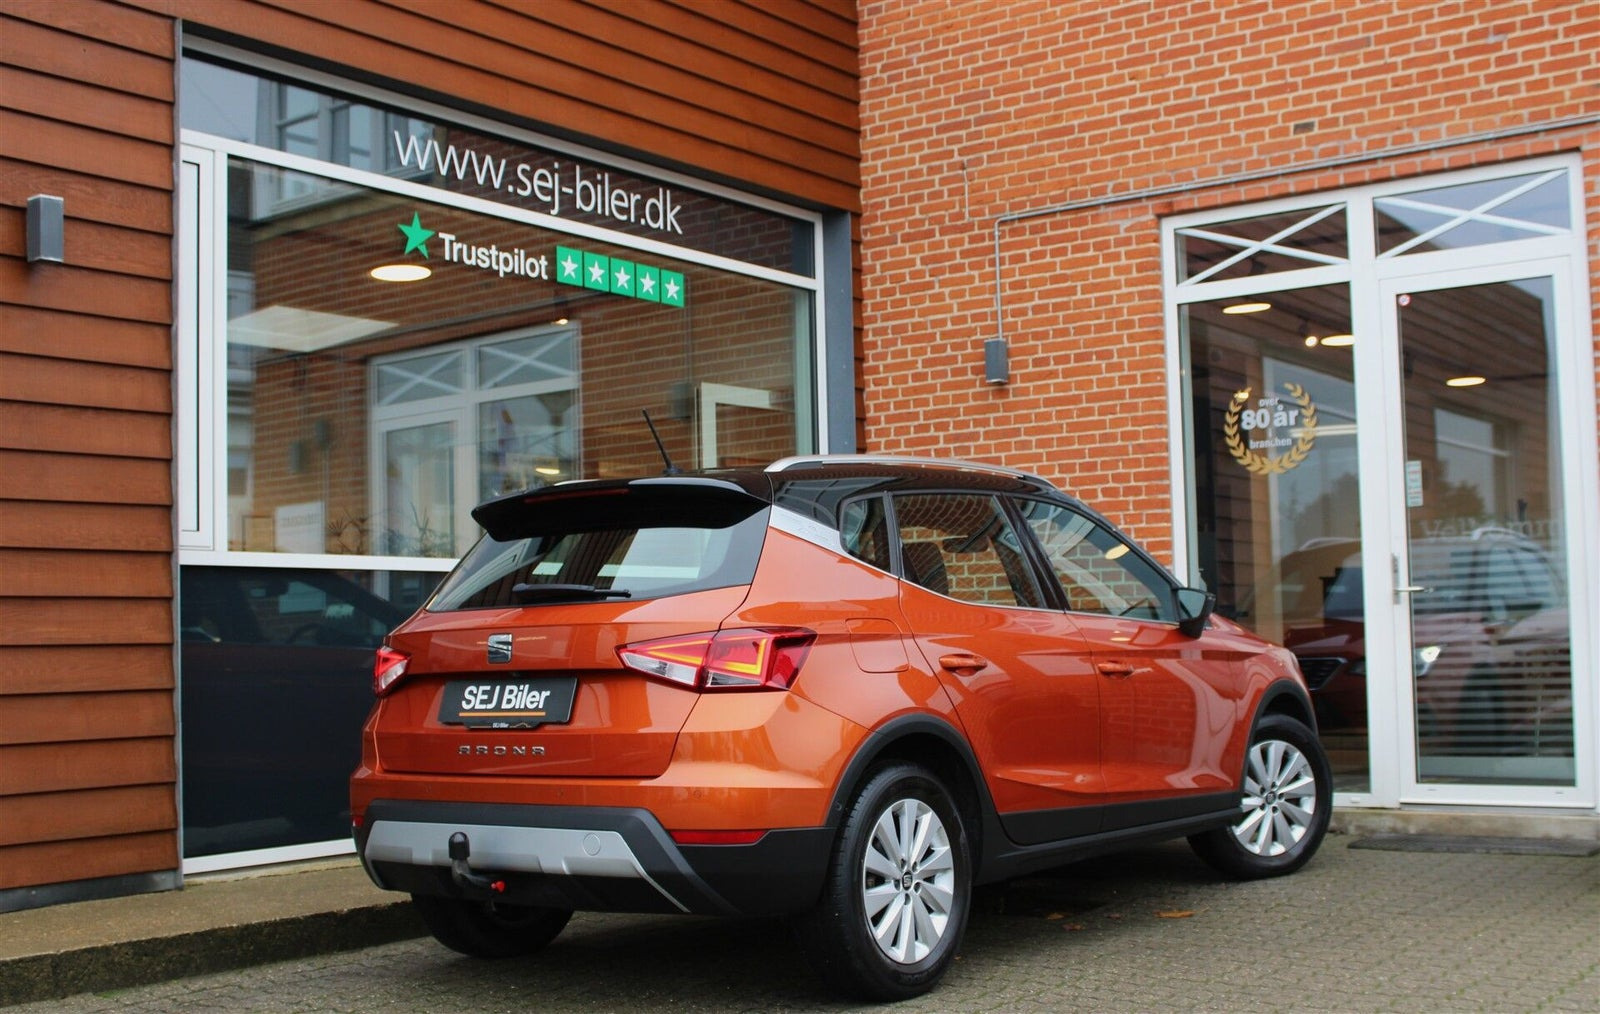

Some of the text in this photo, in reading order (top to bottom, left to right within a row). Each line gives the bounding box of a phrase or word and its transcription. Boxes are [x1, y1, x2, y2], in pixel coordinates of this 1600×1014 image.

[394, 130, 683, 234] www.sej-biler.dk
[438, 232, 549, 280] Trustpilot
[1258, 397, 1280, 408] over
[1241, 404, 1299, 430] 80 år
[461, 684, 551, 710] SEJ Biler
